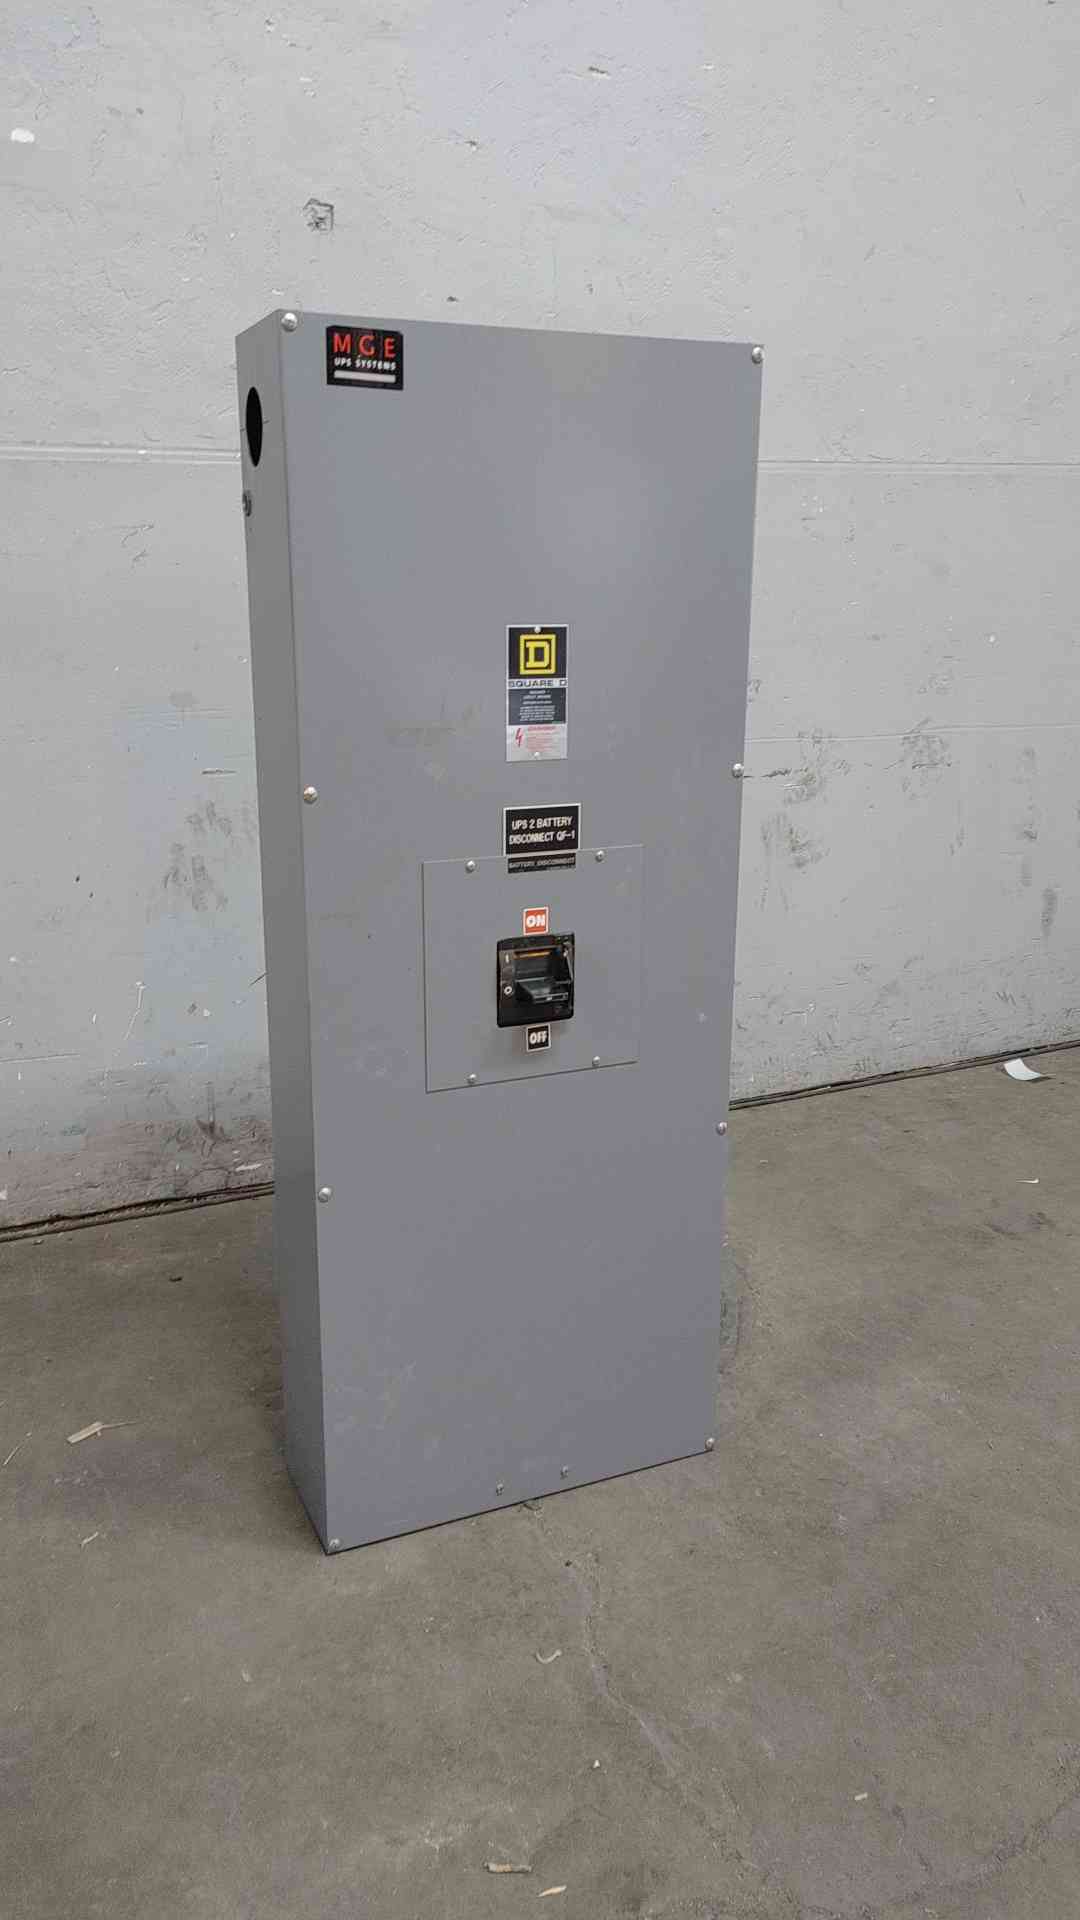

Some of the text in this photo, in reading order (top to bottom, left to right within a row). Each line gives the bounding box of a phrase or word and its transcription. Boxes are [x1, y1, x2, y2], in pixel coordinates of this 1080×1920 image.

[334, 333, 396, 357] MGE
[334, 357, 396, 371] UPS SYSTEMS
[509, 679, 553, 688] SQUARE
[512, 816, 573, 830] UPS 2 BATTERY
[509, 831, 555, 844] DISCONNECT
[526, 914, 546, 927] ON
[529, 1030, 547, 1044] OFF
